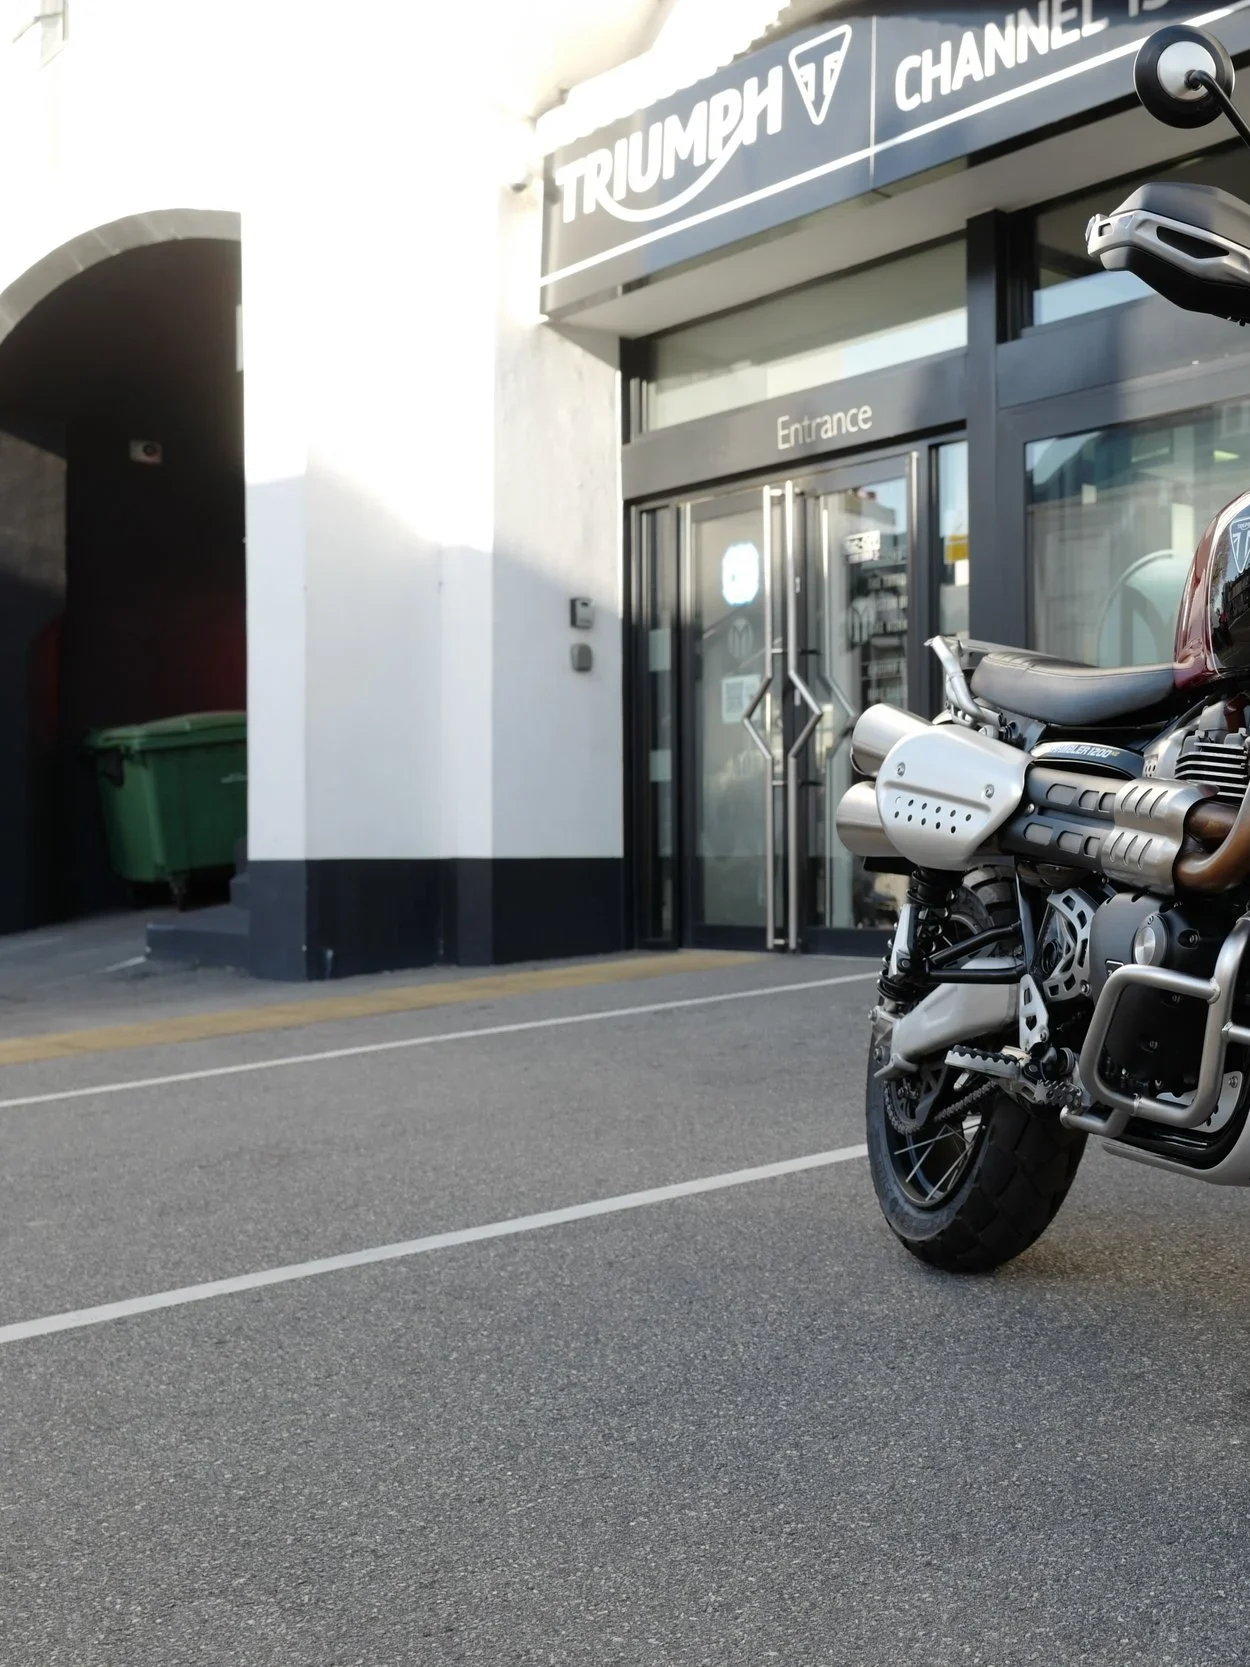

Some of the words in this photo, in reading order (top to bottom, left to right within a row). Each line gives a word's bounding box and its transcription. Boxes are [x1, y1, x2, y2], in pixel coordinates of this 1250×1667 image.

[894, 0, 1109, 112] CHANNEL
[554, 64, 784, 225] TRIUMPH
[777, 404, 873, 450] Entrance
[1087, 745, 1113, 758] 1200
